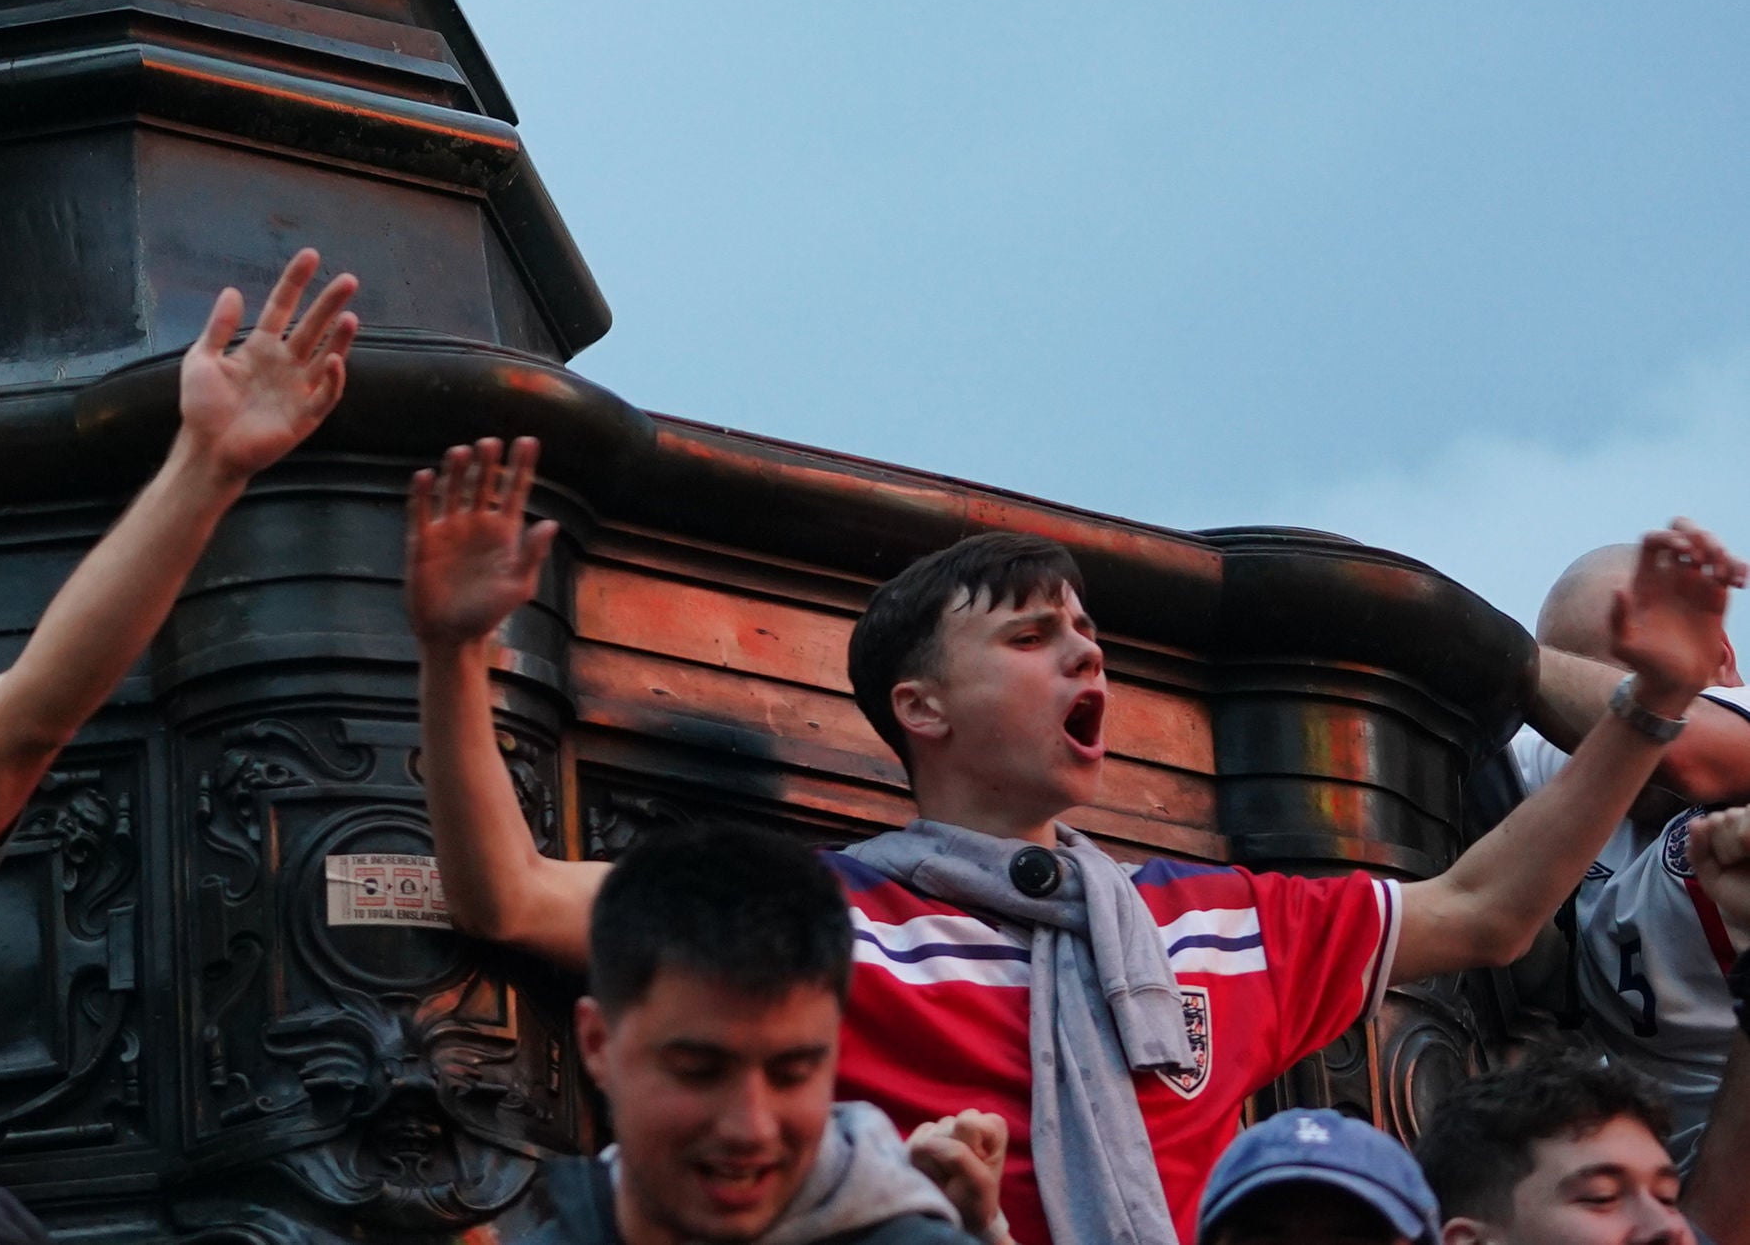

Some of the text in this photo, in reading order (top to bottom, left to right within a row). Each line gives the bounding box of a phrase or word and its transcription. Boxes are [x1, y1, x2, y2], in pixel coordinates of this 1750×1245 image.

[352, 856, 368, 865] THE
[370, 856, 431, 867] INCREMENTAL
[354, 909, 365, 919] TO
[368, 909, 394, 919] TOTAL
